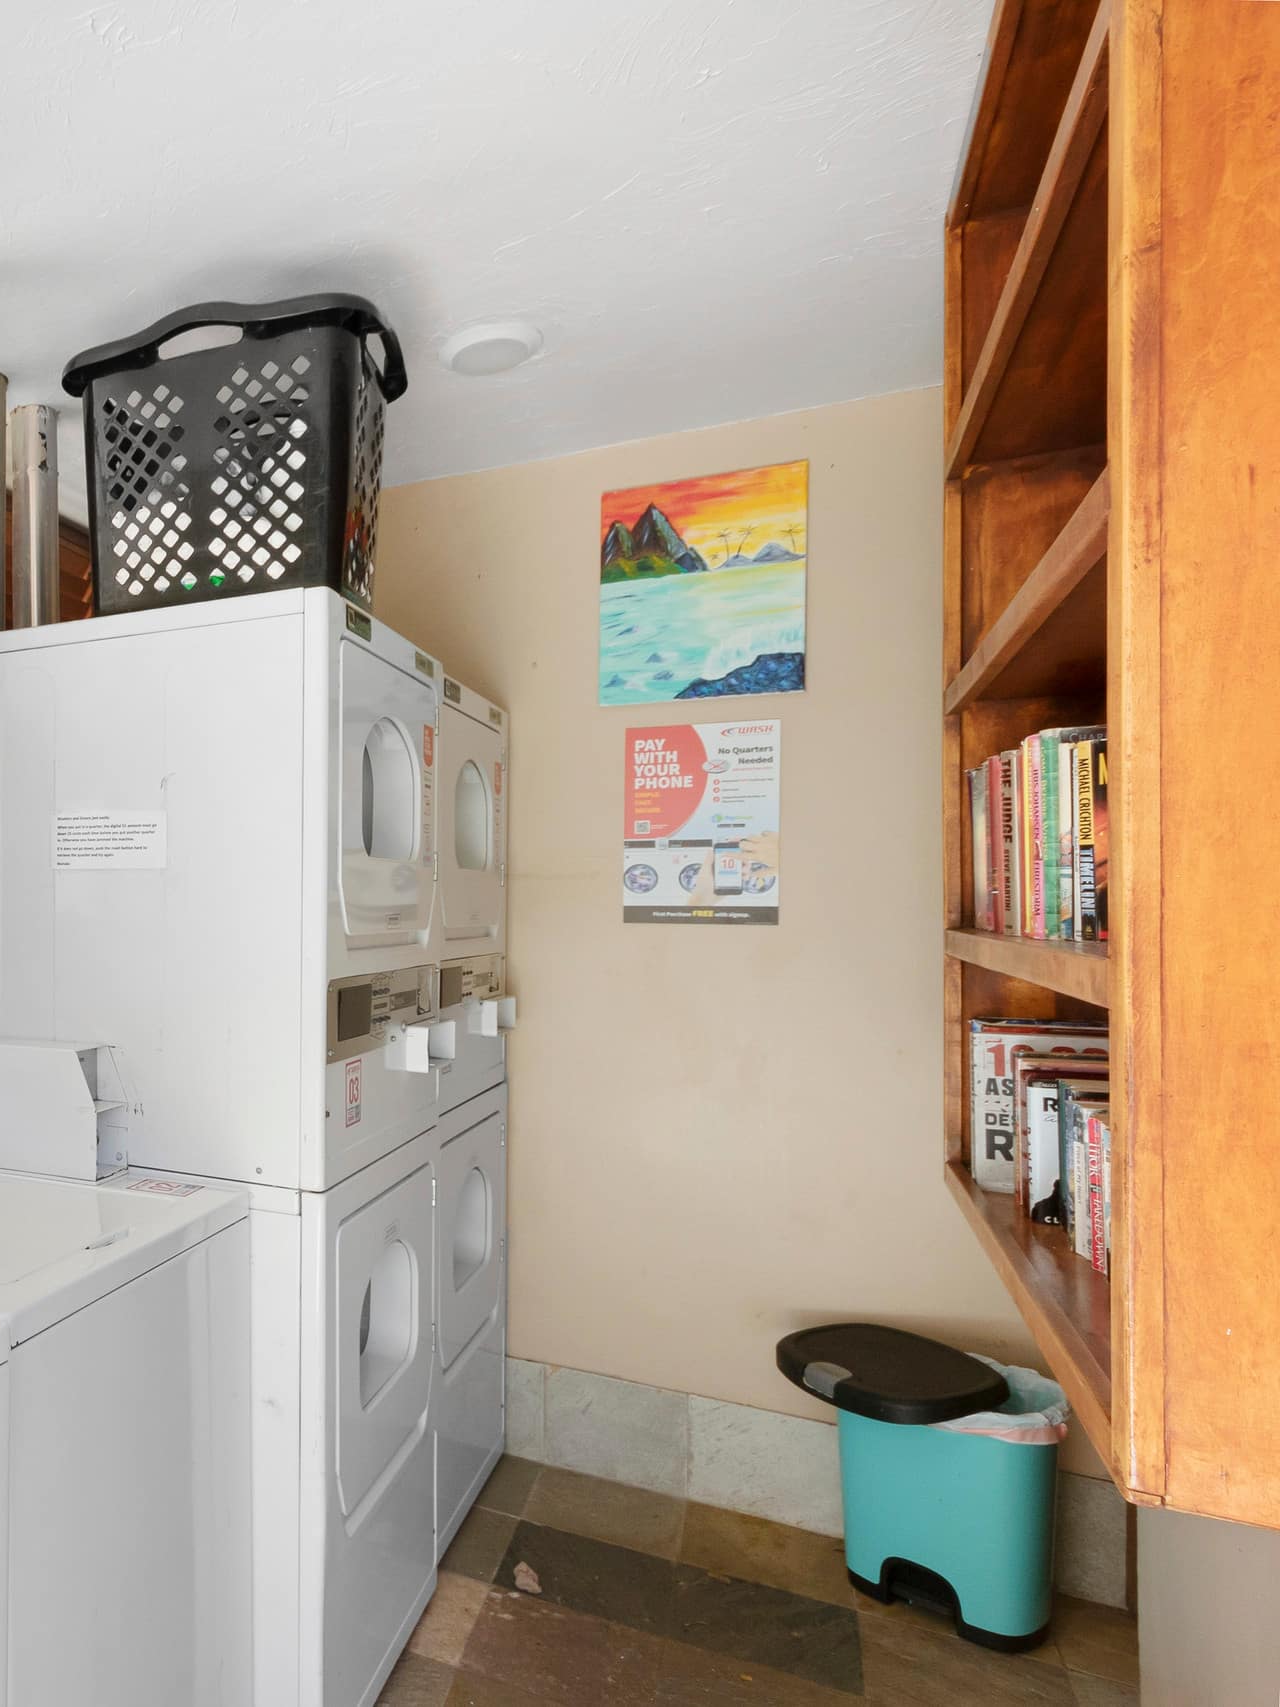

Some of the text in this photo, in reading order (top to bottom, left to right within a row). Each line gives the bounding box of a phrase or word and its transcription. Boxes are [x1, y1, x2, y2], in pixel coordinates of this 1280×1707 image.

[634, 738, 666, 752] PAY
[732, 746, 773, 755] Quarters
[634, 750, 678, 764] WITH
[738, 756, 773, 765] Needed
[634, 763, 680, 777] YOUR
[634, 775, 693, 790] PHONE
[1001, 760, 1013, 843] THE JUDGE
[1078, 758, 1092, 840] MICHAEL CRICHTON
[1080, 847, 1096, 917] TIMELINE
[1089, 1143, 1105, 1268] THOR TAKEDOWN
